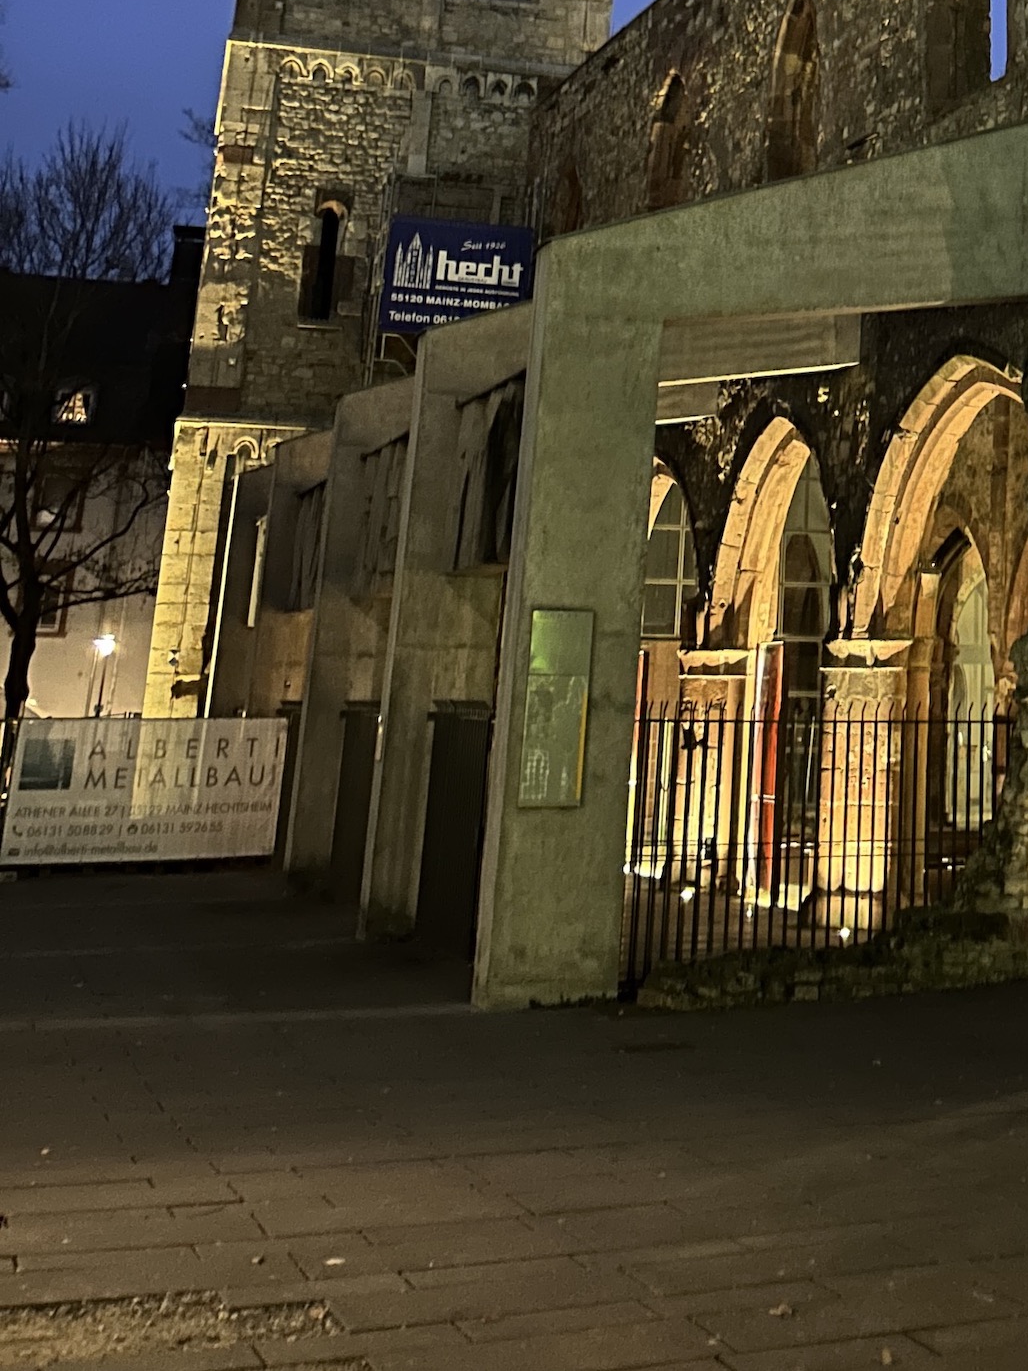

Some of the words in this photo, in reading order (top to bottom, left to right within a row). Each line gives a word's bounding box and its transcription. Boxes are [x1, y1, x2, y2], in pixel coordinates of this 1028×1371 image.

[461, 240, 482, 251] Seit
[436, 250, 524, 287] hecht
[391, 293, 424, 303] 55120
[388, 311, 430, 324] Telefon
[88, 737, 280, 760] ALBERTI
[26, 824, 63, 837] 06131
[140, 822, 175, 835] 06131
